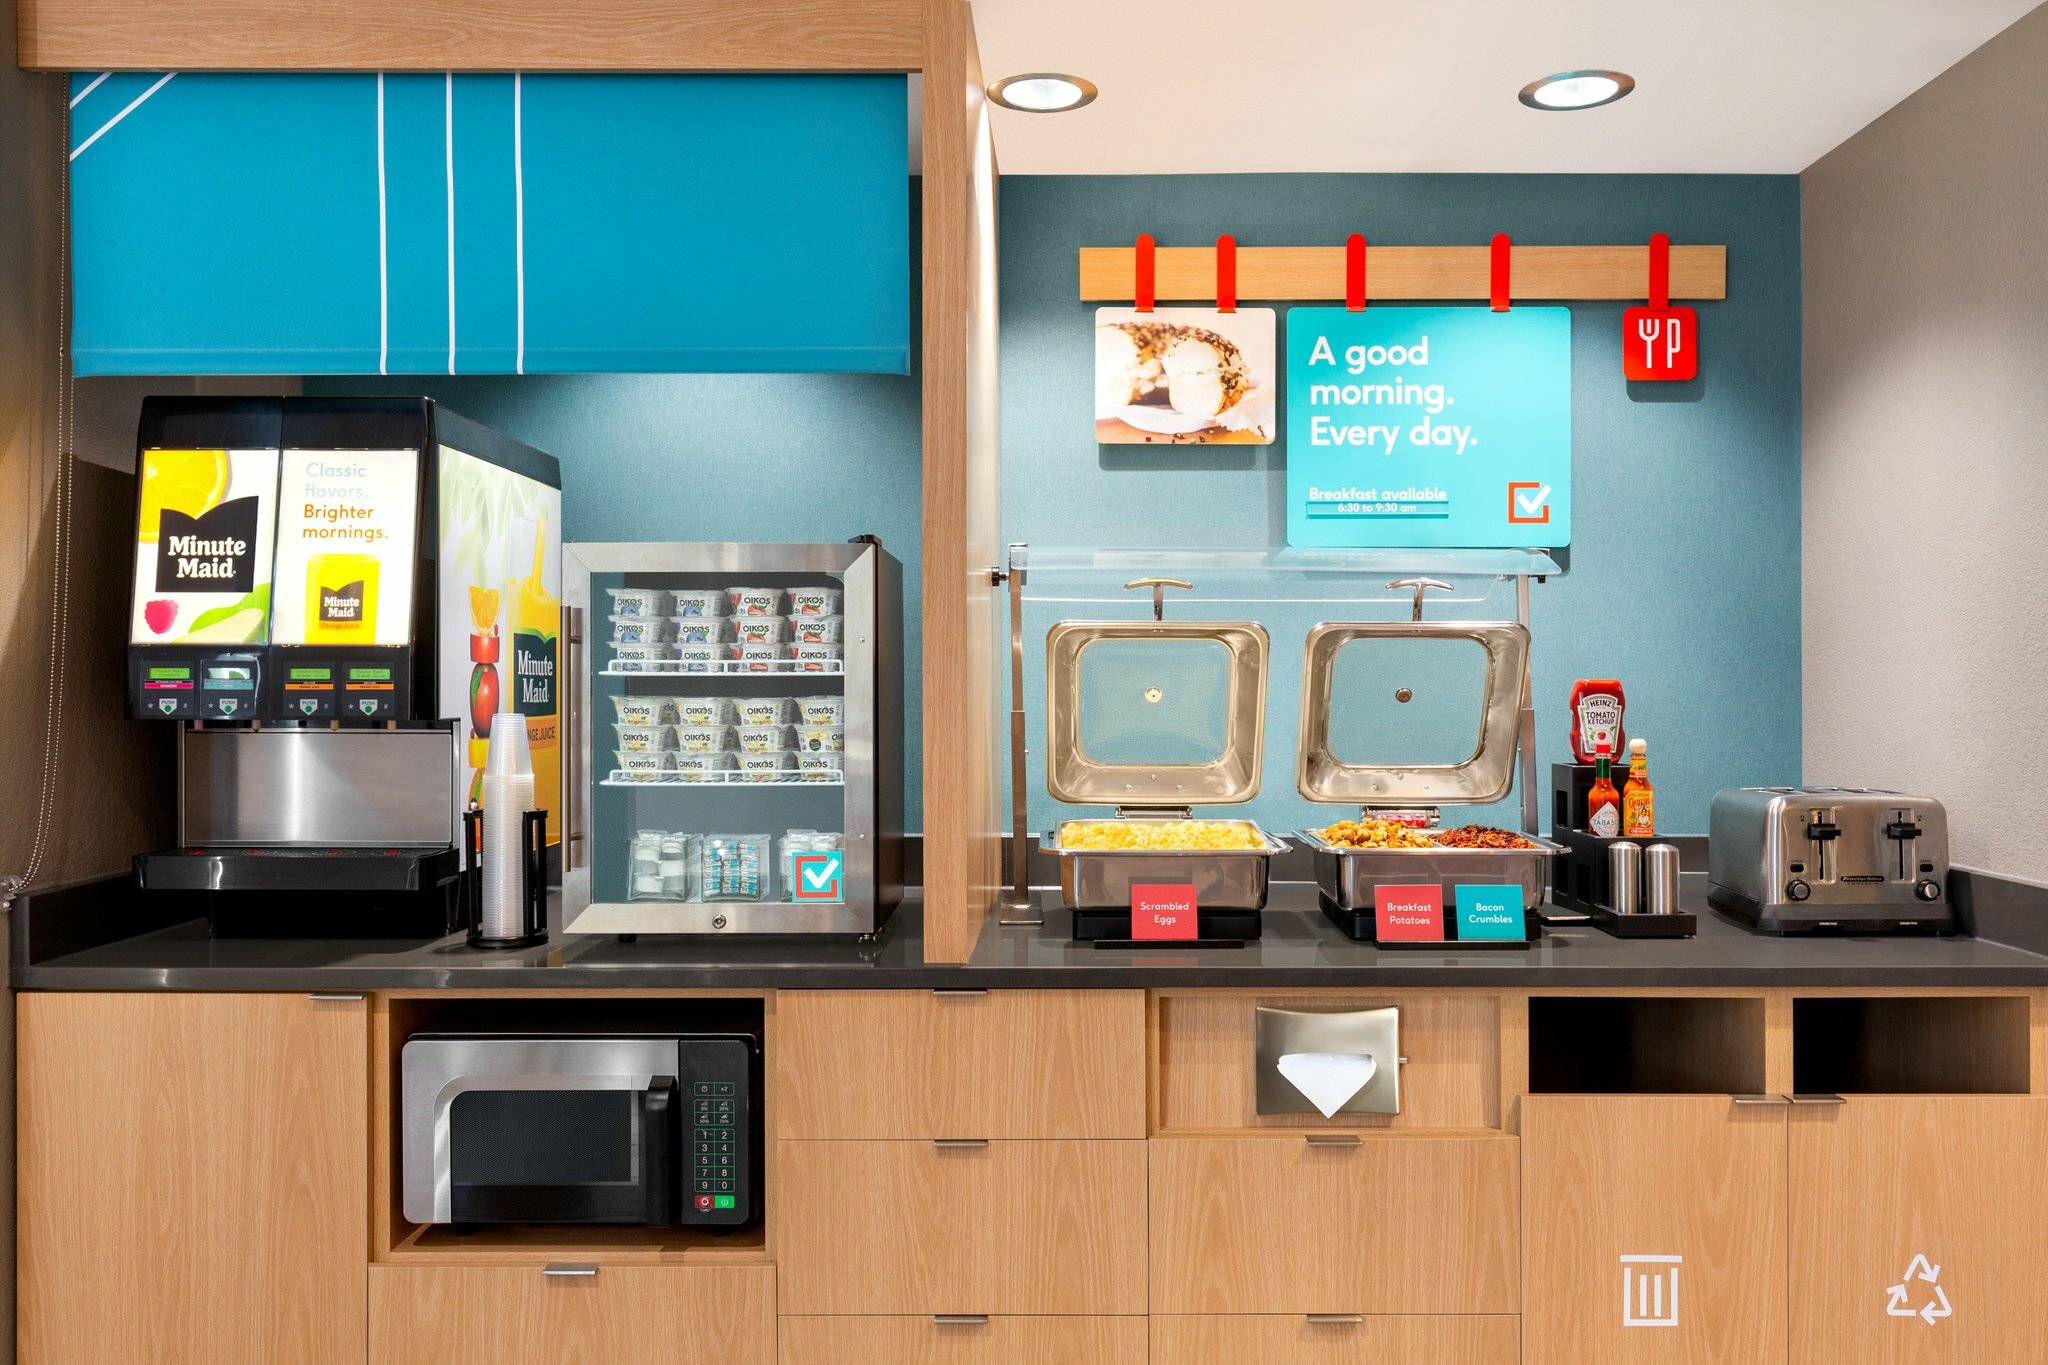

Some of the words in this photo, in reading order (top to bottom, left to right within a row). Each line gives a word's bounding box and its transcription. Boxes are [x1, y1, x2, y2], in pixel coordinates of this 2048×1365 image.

[1308, 336, 1336, 366] A
[1345, 336, 1428, 375] good
[1311, 376, 1455, 414] morning.
[1311, 416, 1400, 455] Every
[1409, 416, 1478, 455] day.
[305, 462, 367, 477] Classic
[305, 482, 368, 498] flavors.
[1309, 487, 1377, 500] Breakfast
[1381, 487, 1447, 500] available
[1337, 503, 1360, 512] 6:30
[1362, 504, 1373, 512] to
[1375, 503, 1398, 512] 9:30
[304, 504, 375, 523] Brighter
[302, 524, 389, 543] mornings.
[167, 535, 247, 556] Minute
[323, 596, 360, 607] Minute
[617, 598, 642, 606] OIKOS
[744, 597, 770, 605] OIKOS
[327, 607, 355, 617] Maid
[618, 624, 644, 632] OIKOS
[684, 652, 711, 660] OIKOS
[801, 651, 827, 659] OIKOS
[517, 649, 554, 677] Minute
[522, 678, 549, 703] Maid
[624, 707, 650, 715] OIKOS
[686, 707, 712, 715] OIKOS
[747, 707, 774, 715] OIKOS
[808, 707, 834, 715] OIKOS
[539, 726, 556, 740] JUICE
[743, 734, 768, 742] OIKOS
[1140, 901, 1189, 911] Scrambled
[1387, 902, 1432, 912] Breakfast
[1475, 902, 1505, 912] Bacon
[1154, 914, 1176, 926] Eggs
[1389, 915, 1431, 925] Potatoes
[1468, 914, 1513, 924] Crumbles
[702, 1144, 707, 1152] 3
